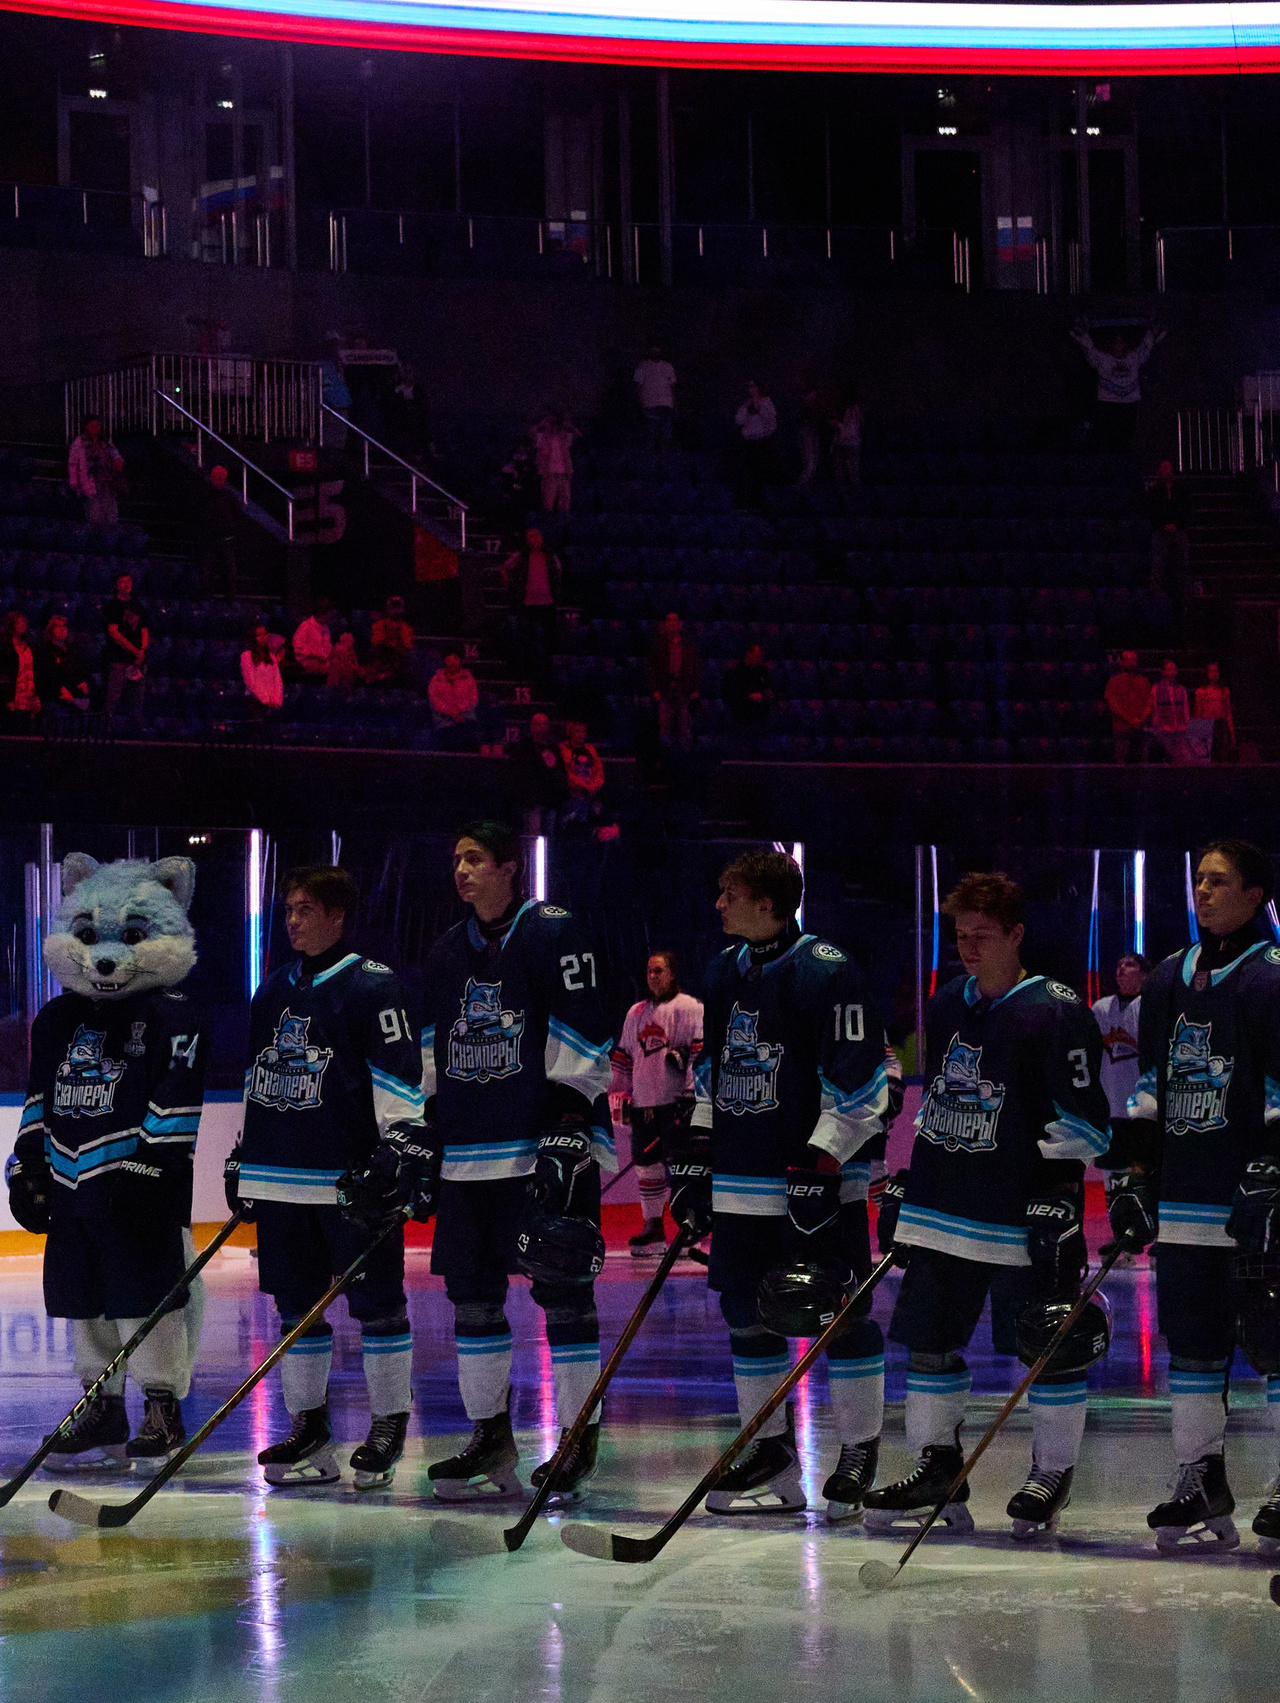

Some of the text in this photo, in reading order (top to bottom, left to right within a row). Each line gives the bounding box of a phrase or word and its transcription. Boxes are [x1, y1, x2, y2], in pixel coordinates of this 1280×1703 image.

[295, 453, 315, 468] E5
[485, 539, 502, 553] 17
[515, 687, 531, 704] 13
[560, 952, 597, 991] 27
[833, 1003, 865, 1042] 10
[1067, 1048, 1091, 1089] 3
[537, 1135, 584, 1149] AUER
[121, 1159, 163, 1178] PRIME
[517, 1233, 530, 1253] 27
[590, 1256, 602, 1273] 27
